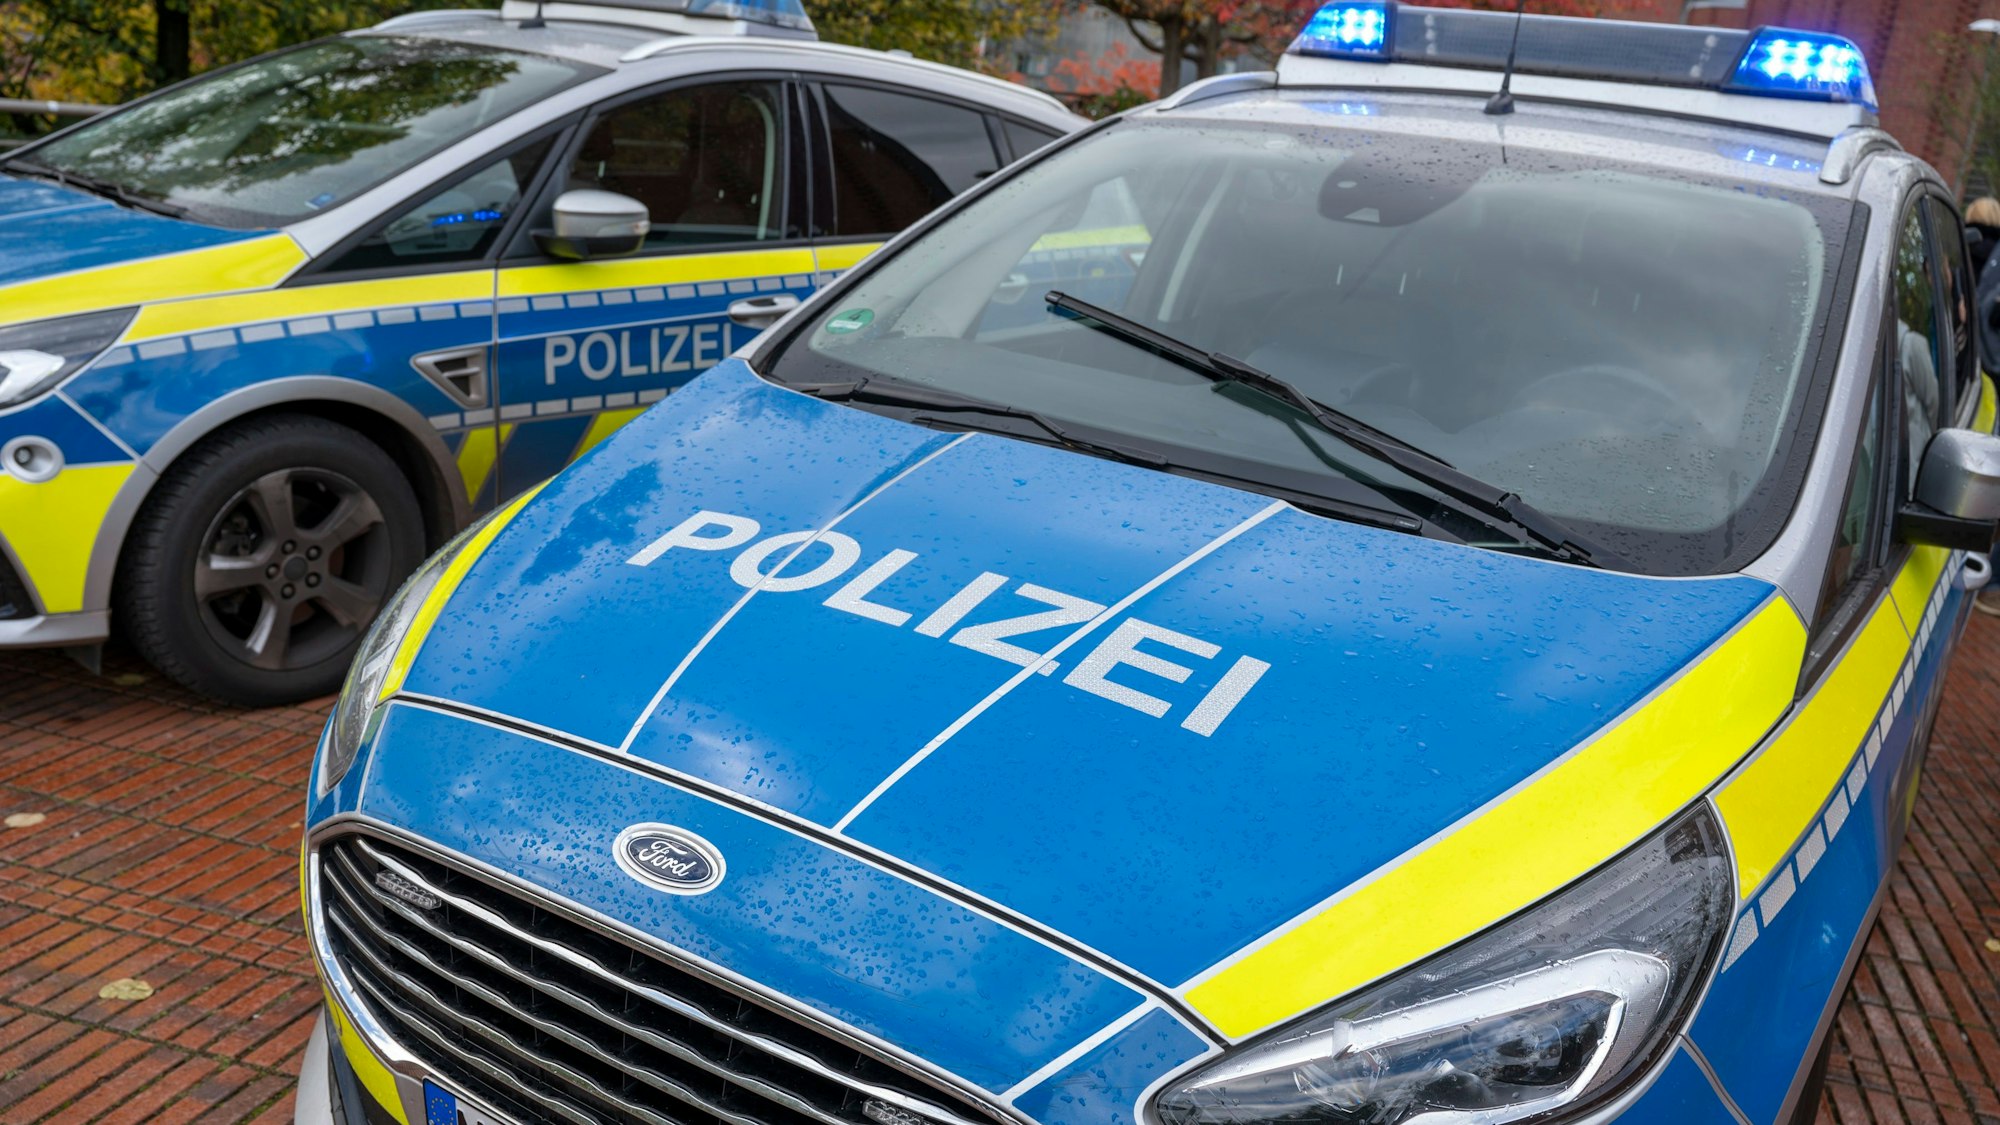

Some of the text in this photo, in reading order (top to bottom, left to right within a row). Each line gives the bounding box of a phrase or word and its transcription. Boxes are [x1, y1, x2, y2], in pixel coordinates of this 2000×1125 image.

[545, 323, 732, 385] POLIZEI
[625, 510, 1271, 737] POLIZEI
[638, 840, 697, 876] Ford
